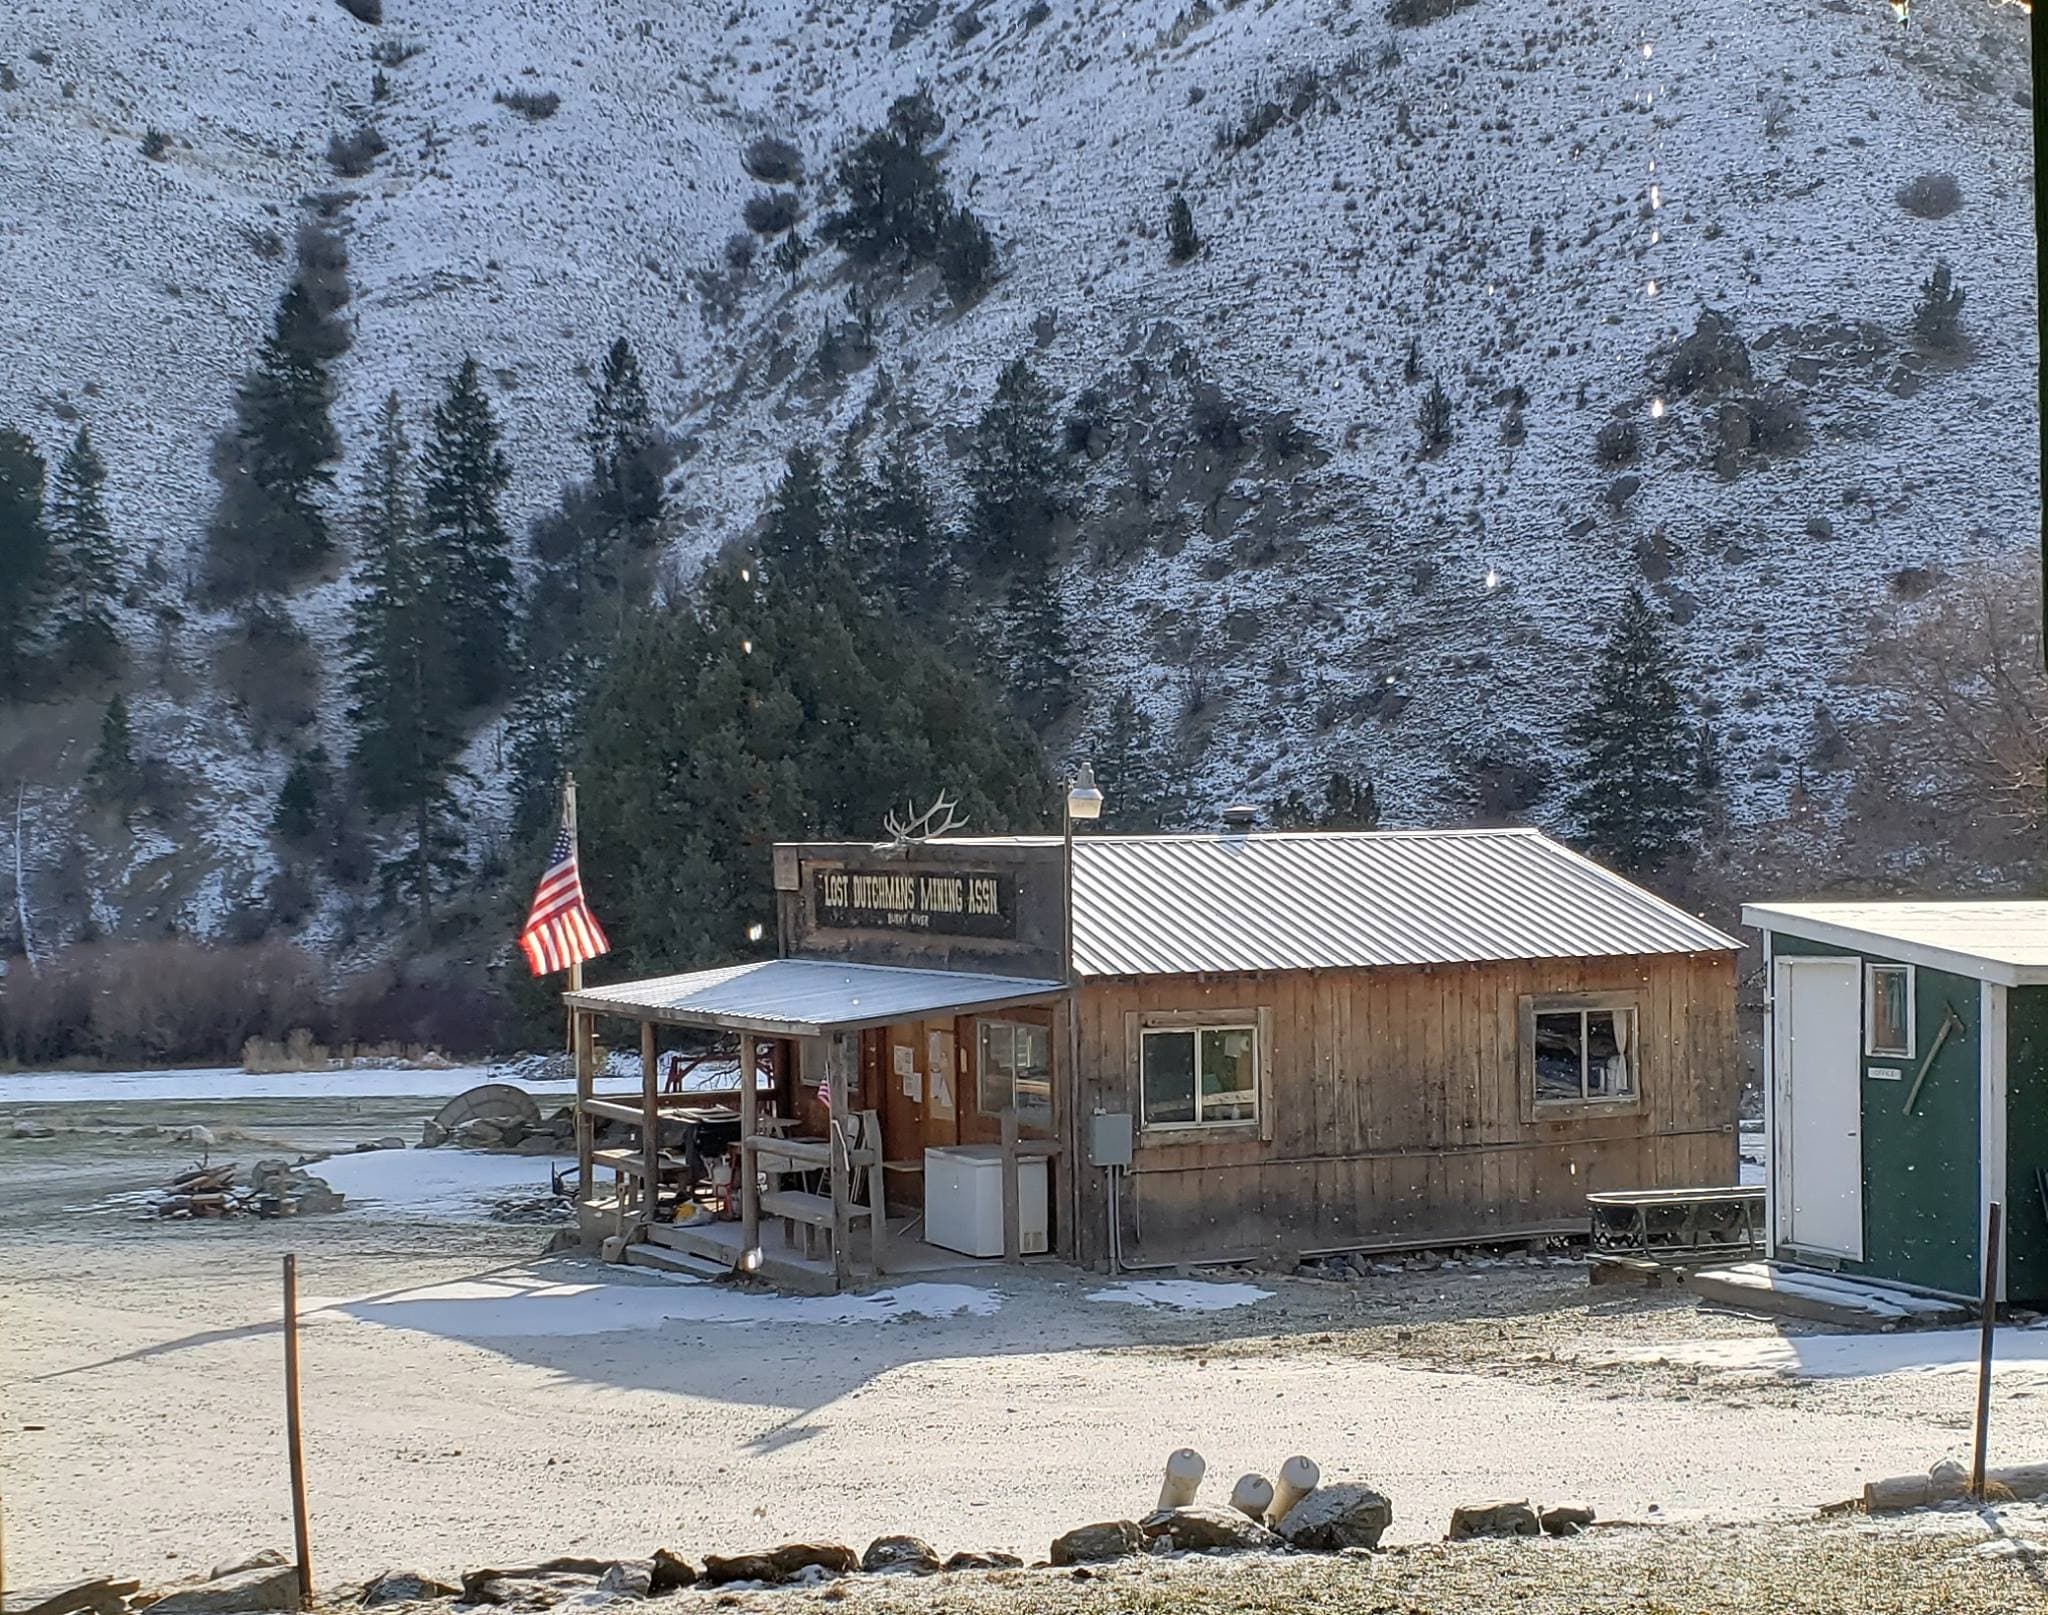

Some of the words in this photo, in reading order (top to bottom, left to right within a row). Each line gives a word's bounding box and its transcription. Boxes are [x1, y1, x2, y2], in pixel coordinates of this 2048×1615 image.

[824, 875, 848, 908] LOST
[853, 875, 915, 910] DUTCHMANS
[920, 877, 963, 913] MINING
